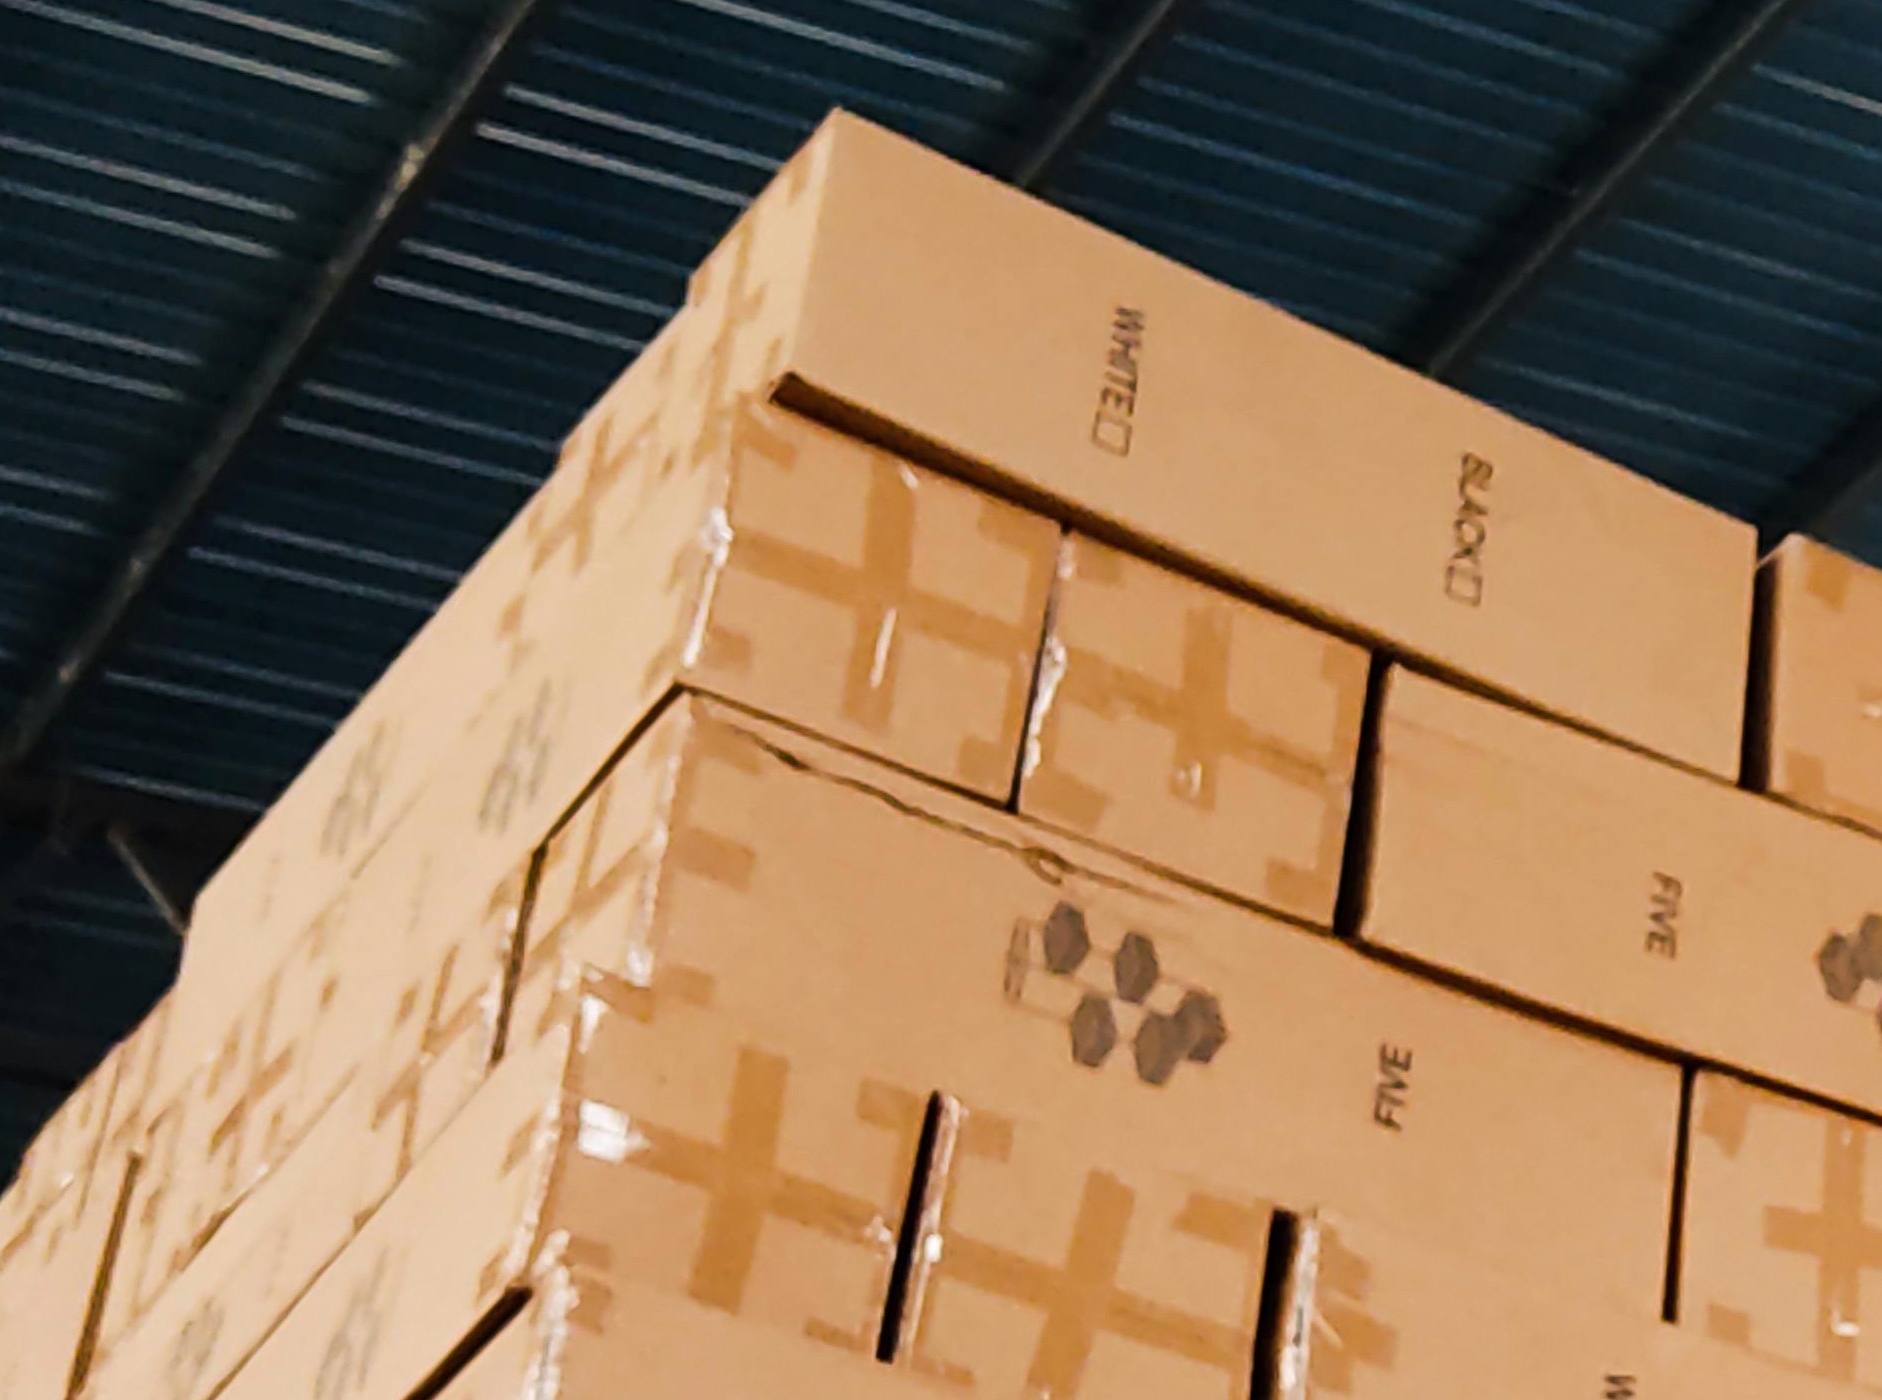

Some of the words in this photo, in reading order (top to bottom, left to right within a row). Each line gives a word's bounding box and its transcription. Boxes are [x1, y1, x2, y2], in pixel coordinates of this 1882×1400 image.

[1100, 306, 1145, 416] WHITE
[1451, 453, 1493, 566] BLACK
[1645, 872, 1682, 959] FIVE
[1373, 1043, 1412, 1132] FIVE
